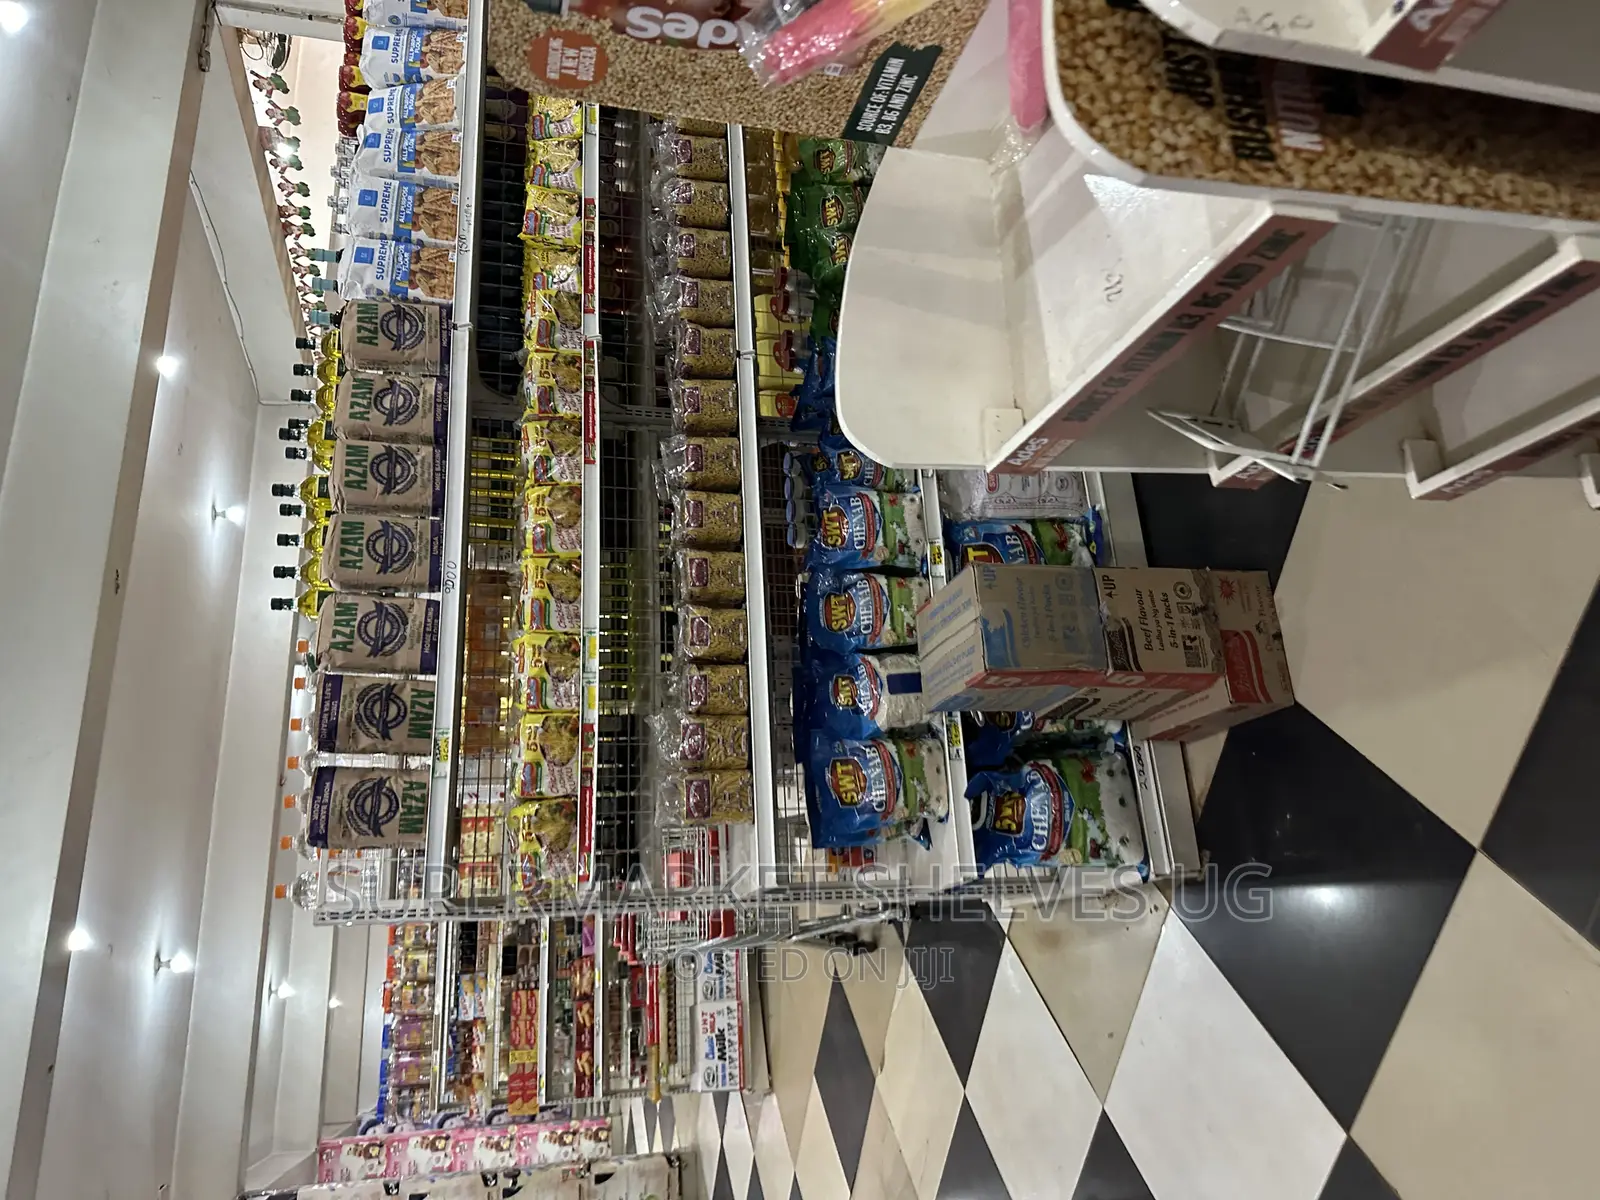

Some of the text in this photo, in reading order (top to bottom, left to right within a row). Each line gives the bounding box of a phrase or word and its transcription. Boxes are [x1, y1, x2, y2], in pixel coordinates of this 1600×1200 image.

[391, 29, 403, 64] SUPREME
[562, 48, 579, 67] NEW
[386, 88, 396, 124] SUPREME
[856, 102, 883, 132] SOURCE
[881, 110, 900, 121] B6
[888, 94, 908, 110] AND
[384, 128, 394, 162] SUPREME
[820, 151, 830, 174] SWT
[379, 182, 392, 222] SUPREME
[400, 186, 408, 212] PURPOSE
[406, 196, 414, 214] FLOUR
[825, 199, 838, 226] SWT
[376, 240, 388, 280] SUPREME
[834, 238, 847, 263] SWT
[356, 304, 378, 346] AZAM
[1060, 390, 1119, 422] SOURCE
[1214, 262, 1266, 290] AND
[349, 378, 374, 421] AZAM
[344, 444, 368, 490] AZAM
[841, 454, 855, 479] SWT
[1006, 437, 1049, 466] AdeS
[535, 507, 545, 516] 5
[822, 509, 842, 546] SWT
[850, 497, 866, 550] CHENAB
[339, 521, 364, 570] AZAM
[554, 523, 568, 550] Chicken
[535, 580, 545, 589] 5
[983, 567, 996, 581] UP
[1102, 575, 1116, 590] UP
[553, 595, 567, 628] Chicken
[830, 594, 847, 630] SWT
[856, 579, 873, 634] CHENAB
[1016, 577, 1030, 648] Chicken Flavour
[1044, 584, 1056, 642] 5-in-1 Packs
[1135, 589, 1154, 651] Beef Flavour
[1160, 592, 1179, 648] 5-in-1 Packs
[329, 602, 359, 653] AZAM
[1155, 619, 1162, 628] ya
[1156, 629, 1165, 651] Ladha
[551, 676, 564, 707] Chicken
[837, 677, 852, 705] SWT
[407, 688, 435, 738] AZAM
[526, 742, 538, 752] 5
[547, 761, 558, 794] Chicken
[557, 770, 568, 794] LADHA
[566, 767, 576, 793] KUKU
[836, 762, 858, 803] SWT
[865, 747, 886, 812] CHENAB
[398, 781, 427, 834] AZAM
[715, 1028, 726, 1061] Milk
